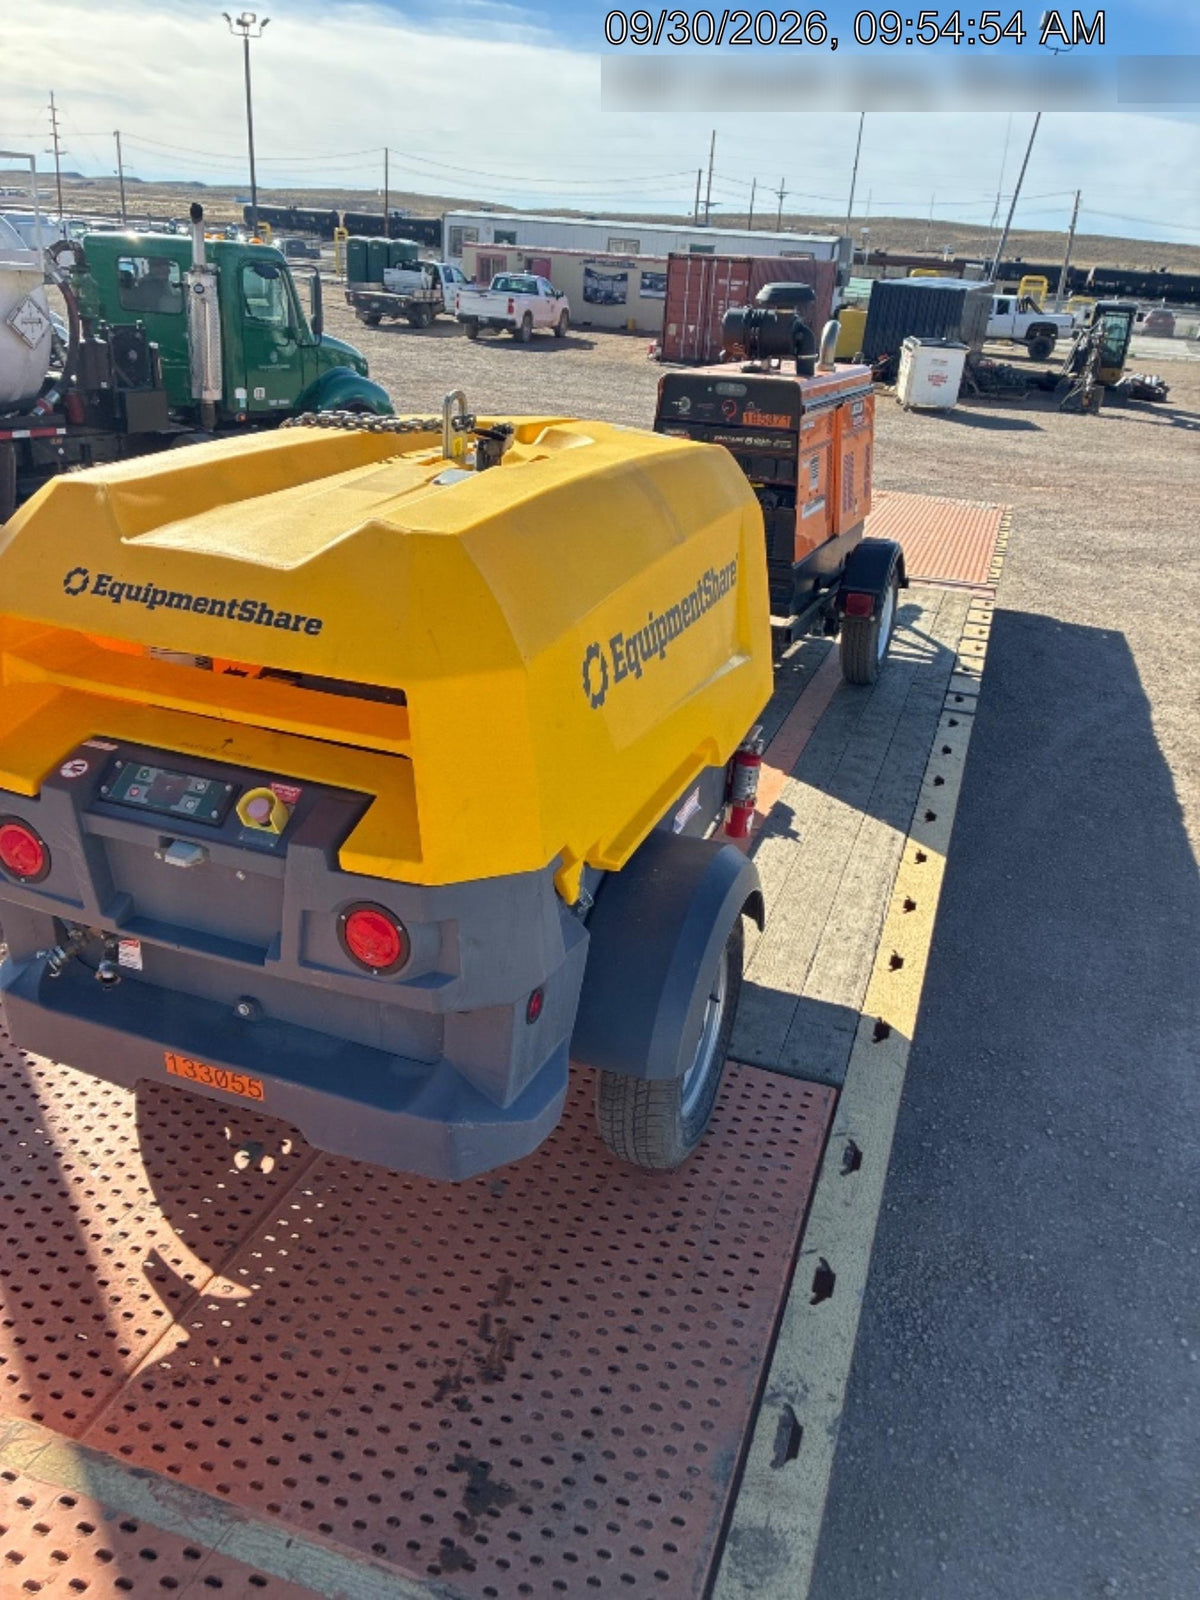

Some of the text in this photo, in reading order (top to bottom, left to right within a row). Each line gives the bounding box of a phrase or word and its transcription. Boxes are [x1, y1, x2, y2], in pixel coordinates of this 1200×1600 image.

[91, 573, 323, 636] EquipmentShare
[609, 563, 737, 684] EquipmentShare
[167, 1054, 263, 1098] 133055
